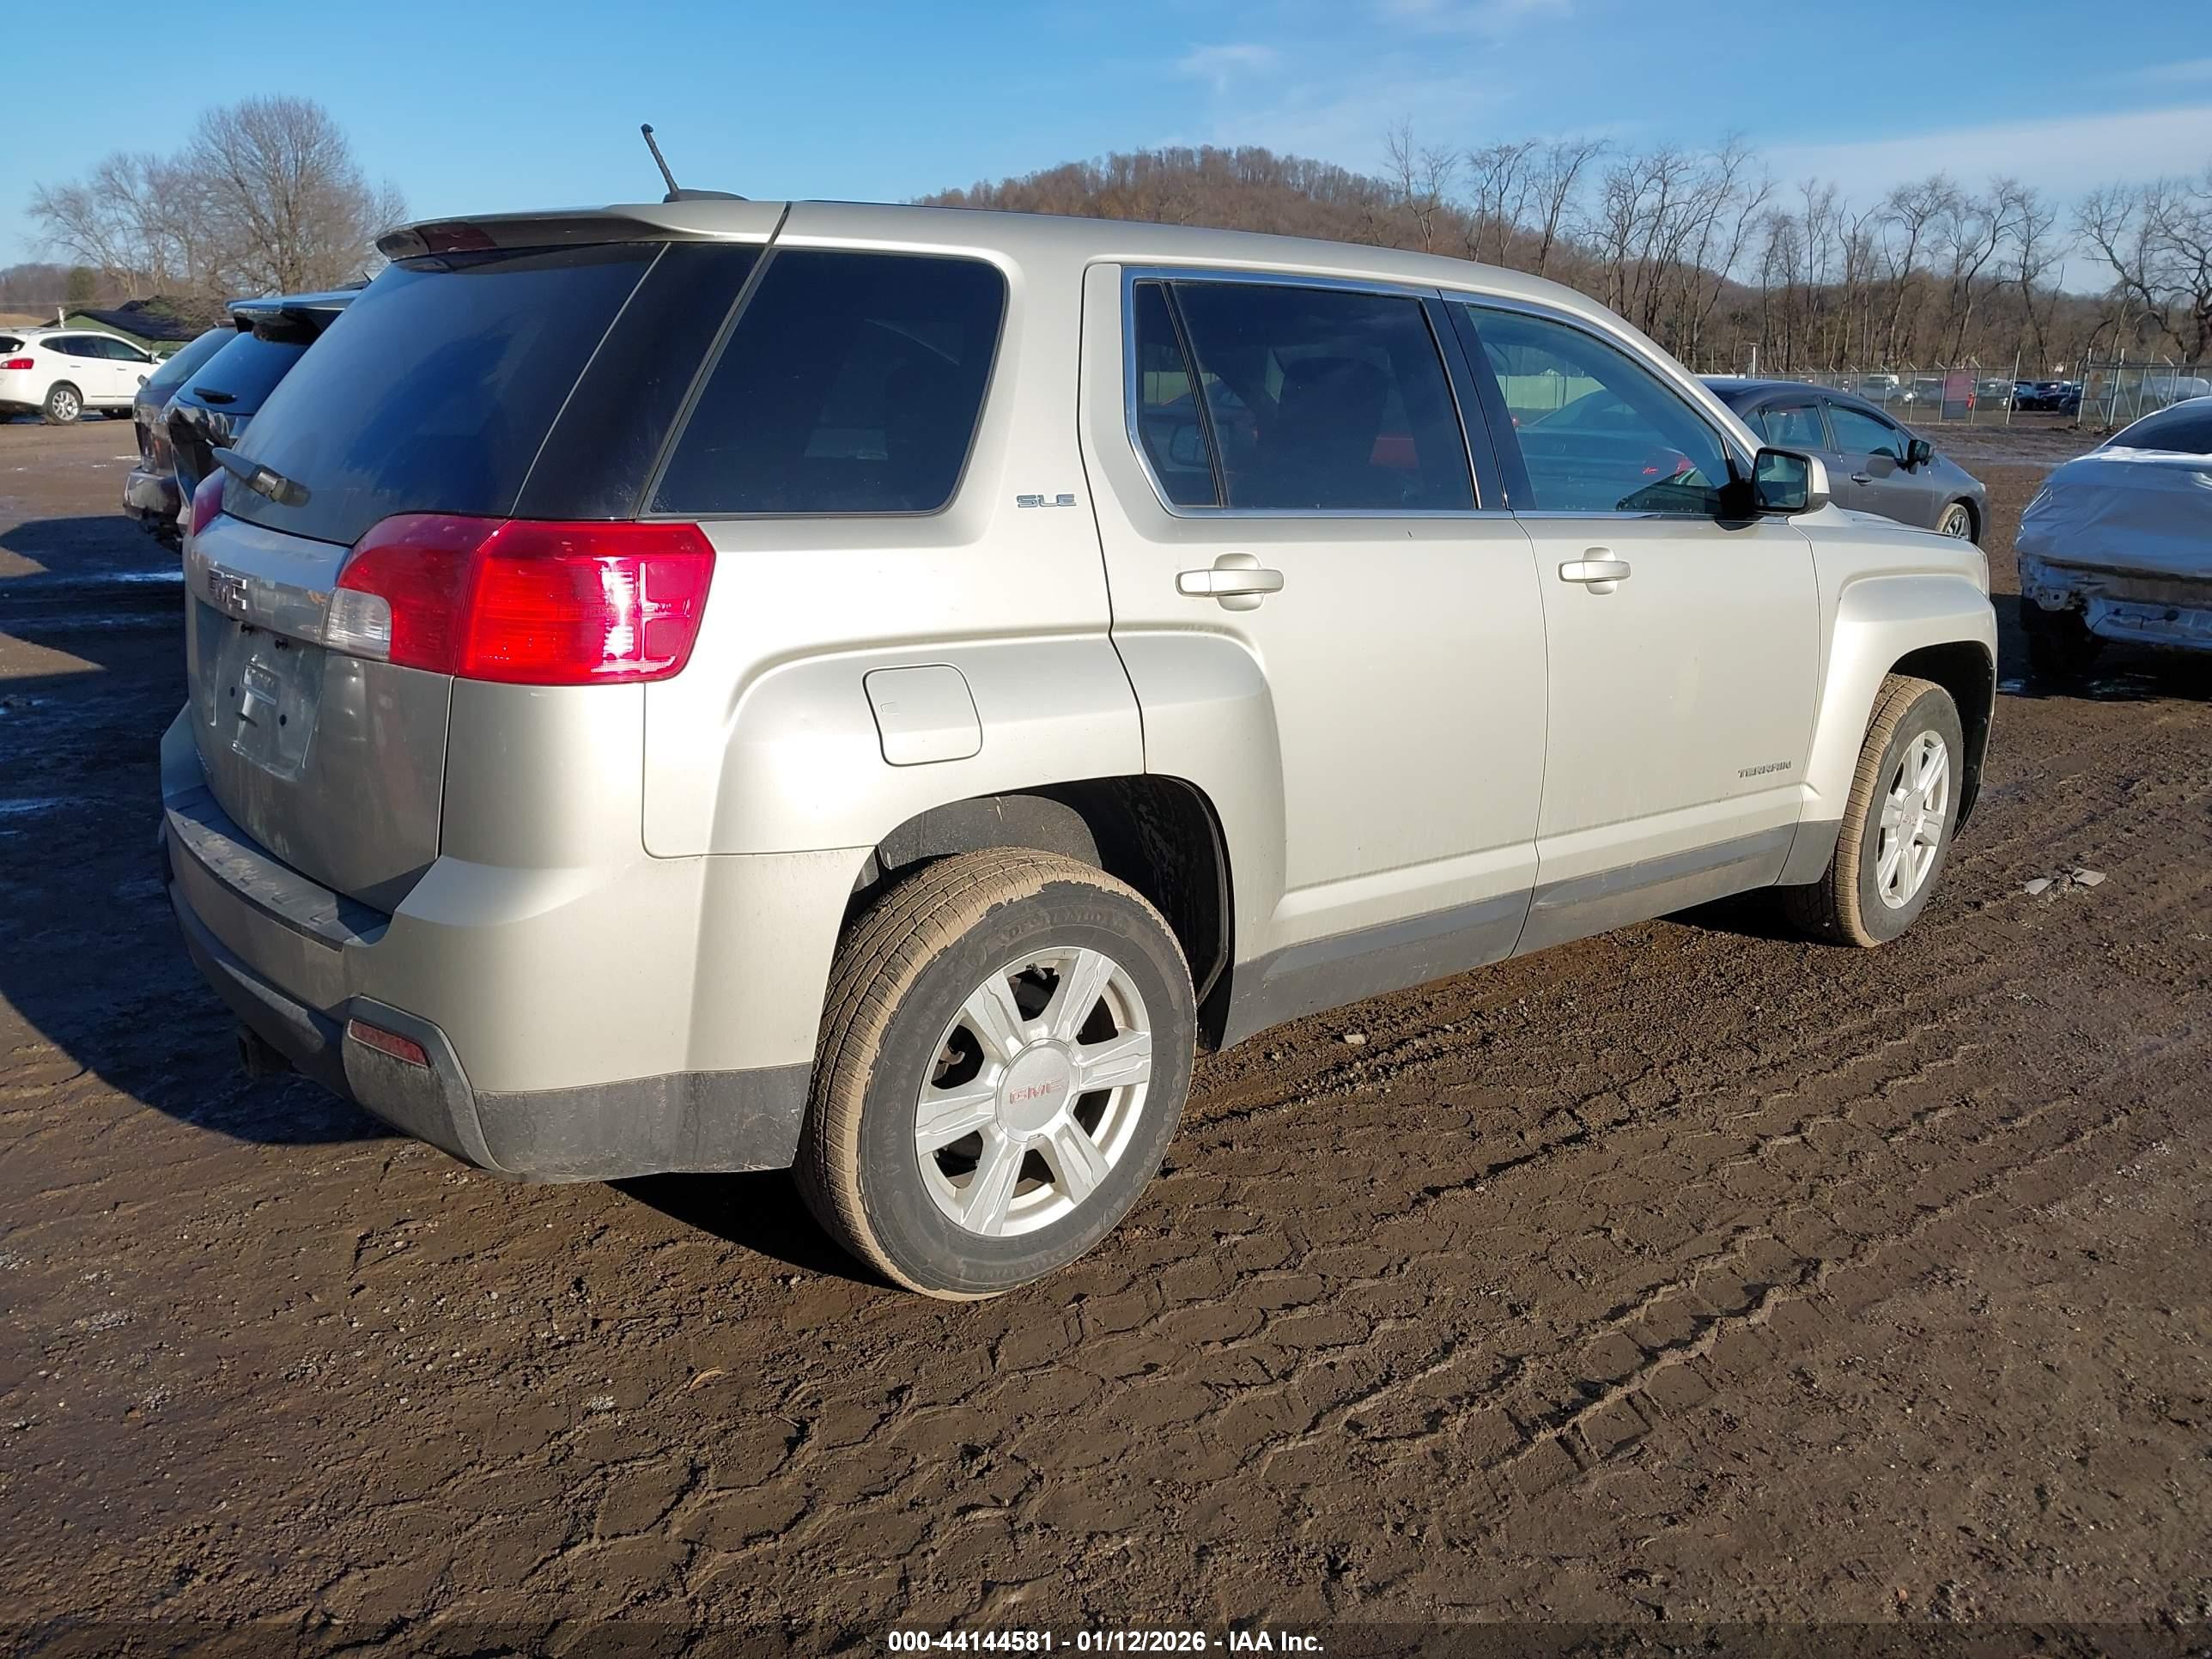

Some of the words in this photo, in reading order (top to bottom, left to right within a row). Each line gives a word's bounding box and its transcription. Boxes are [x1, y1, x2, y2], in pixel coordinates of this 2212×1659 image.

[1016, 493, 1077, 508] SLE
[1737, 760, 1792, 778] TERRAIN
[1009, 1077, 1066, 1105] GMC
